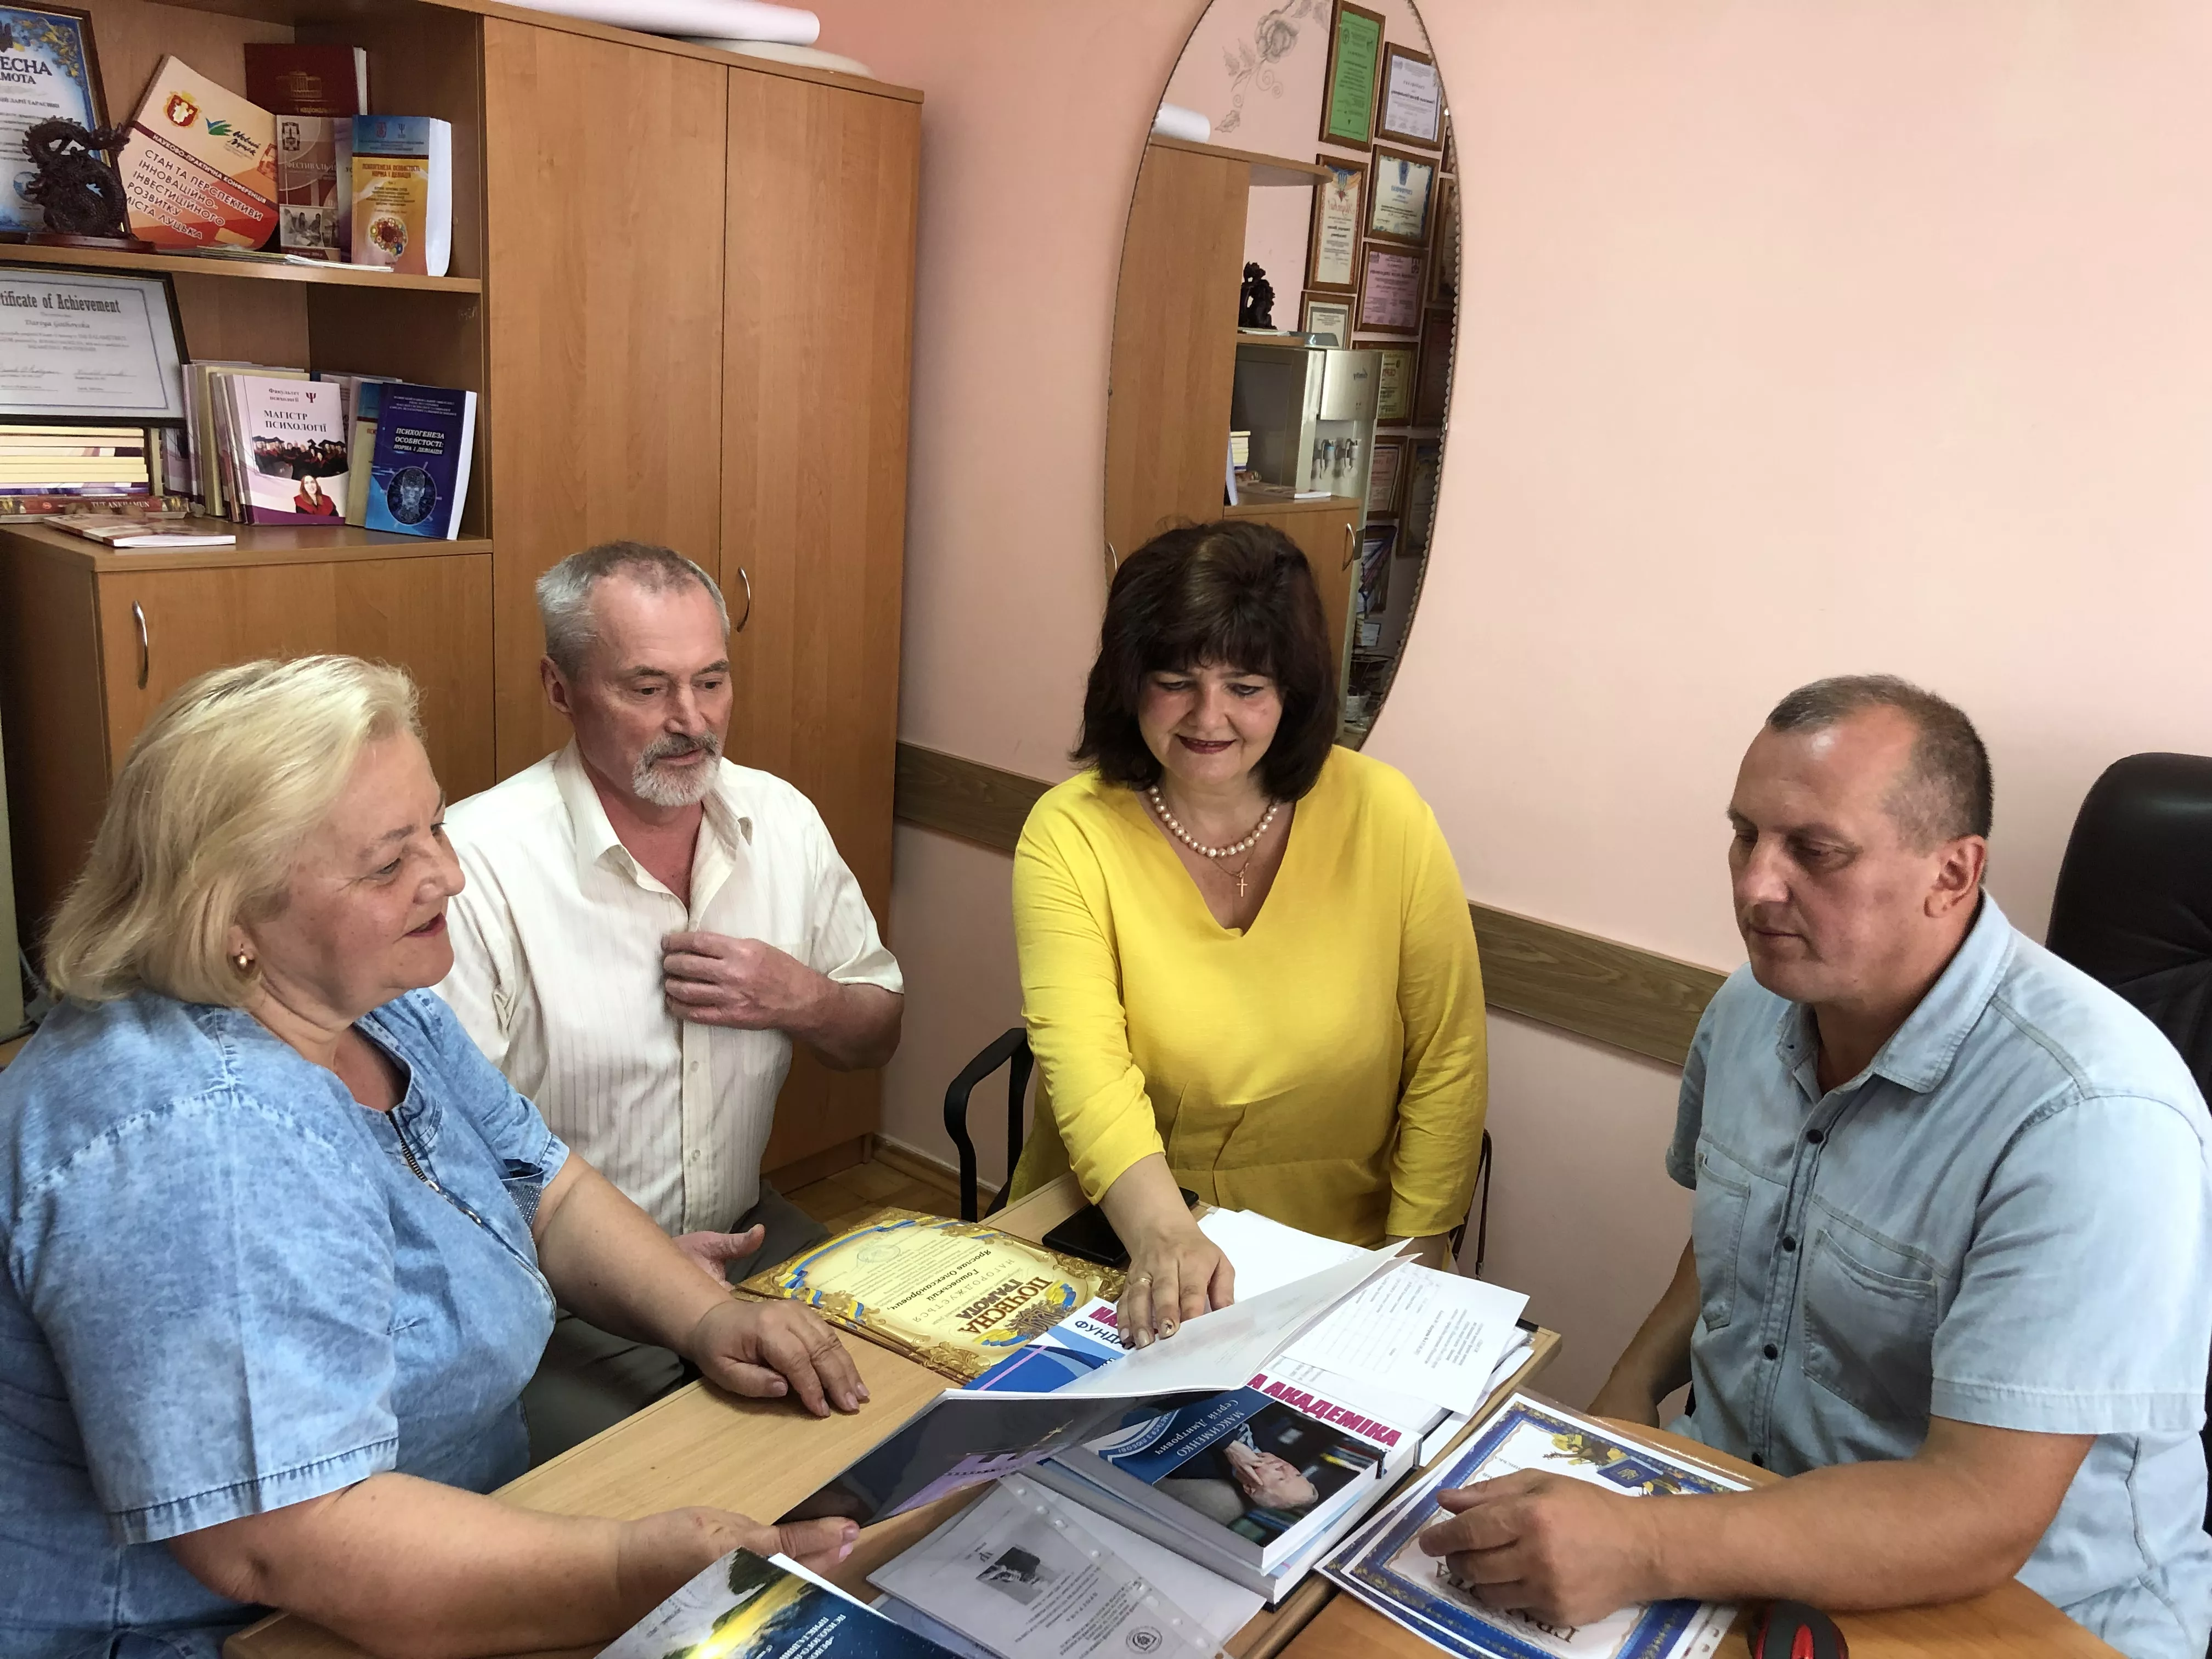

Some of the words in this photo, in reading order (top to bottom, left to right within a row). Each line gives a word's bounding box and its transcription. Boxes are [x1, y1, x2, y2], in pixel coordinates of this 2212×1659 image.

[0, 57, 52, 77] ЕСНА
[139, 160, 218, 211] ІННОВАЦІЙНО-
[145, 149, 173, 172] СТАН
[176, 166, 189, 180] ТА
[190, 175, 263, 221] ПЕРСПЕКТИВИ
[153, 133, 222, 180] НАУКОВО-ПРАКТИЧНА
[223, 174, 267, 204] КОНФЕРЕНЦІЯ
[127, 182, 182, 217] РОЗВИТКУ
[132, 170, 225, 227] ІНВЕСТИЦІЙНОГО
[126, 196, 155, 217] МІСТА
[158, 215, 202, 240] ЛУЦЬКА
[0, 292, 37, 309] tificate
[42, 292, 53, 309] of
[58, 294, 121, 313] Achievement
[264, 409, 308, 420] МАГІСТР
[266, 420, 326, 433] ПСИХОЛОГІЇ
[396, 427, 445, 439] ПСИХОГЕНЕЗА
[395, 436, 444, 448] ОСОБИСТОСТІ:
[956, 1249, 992, 1272] Ярослав
[887, 1268, 958, 1312] Олександрович,
[912, 1259, 1015, 1322] НАГОРОДЖУЄТЬСЯ
[927, 1268, 979, 1302] Гошовський
[955, 1279, 1024, 1319] ГРАМОТА
[957, 1277, 1052, 1335] ПОЧЕСНА
[1207, 1400, 1239, 1420] Сергій
[1263, 1382, 1403, 1448] АКАДЕМІКА
[1154, 1418, 1208, 1455] Дмитрович
[1176, 1409, 1245, 1457] МАКСИМЕНКО
